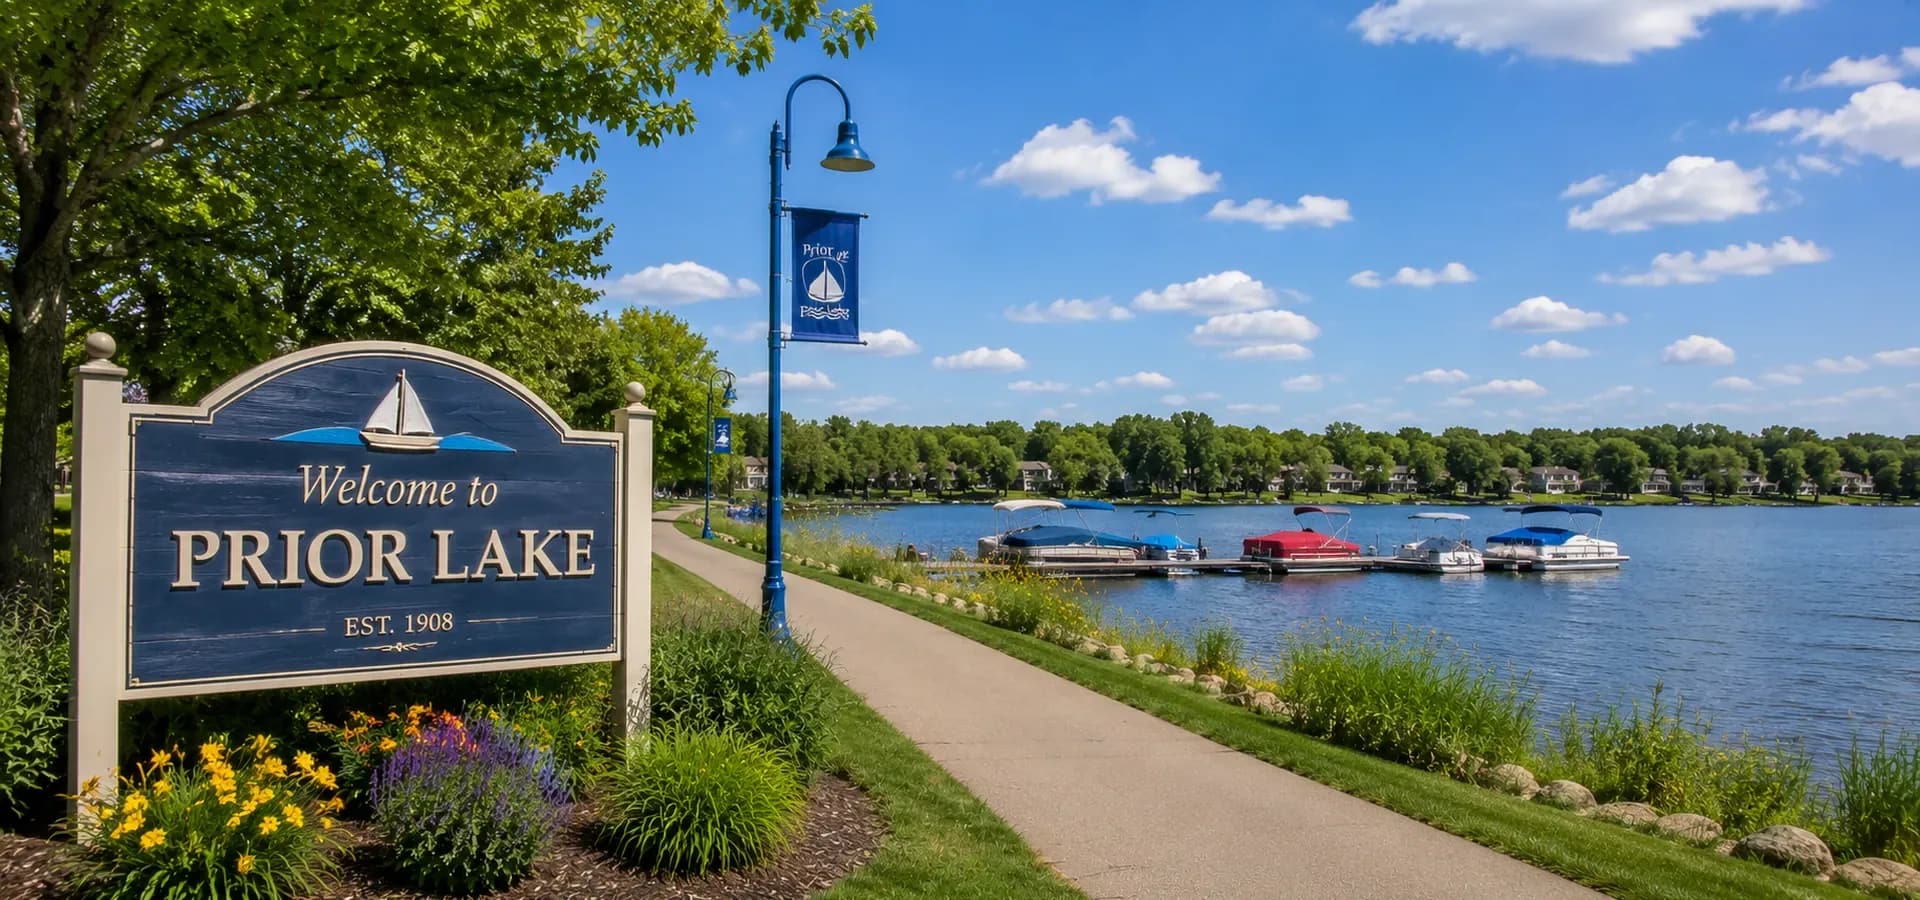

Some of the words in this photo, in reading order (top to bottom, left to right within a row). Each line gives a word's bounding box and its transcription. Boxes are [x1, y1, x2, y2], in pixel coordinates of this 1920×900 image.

[299, 464, 457, 506] Welcome
[467, 476, 499, 507] to
[170, 528, 414, 591] PRIOR
[432, 528, 596, 582] LAKE
[344, 615, 395, 637] EST.
[404, 612, 454, 633] 1908
